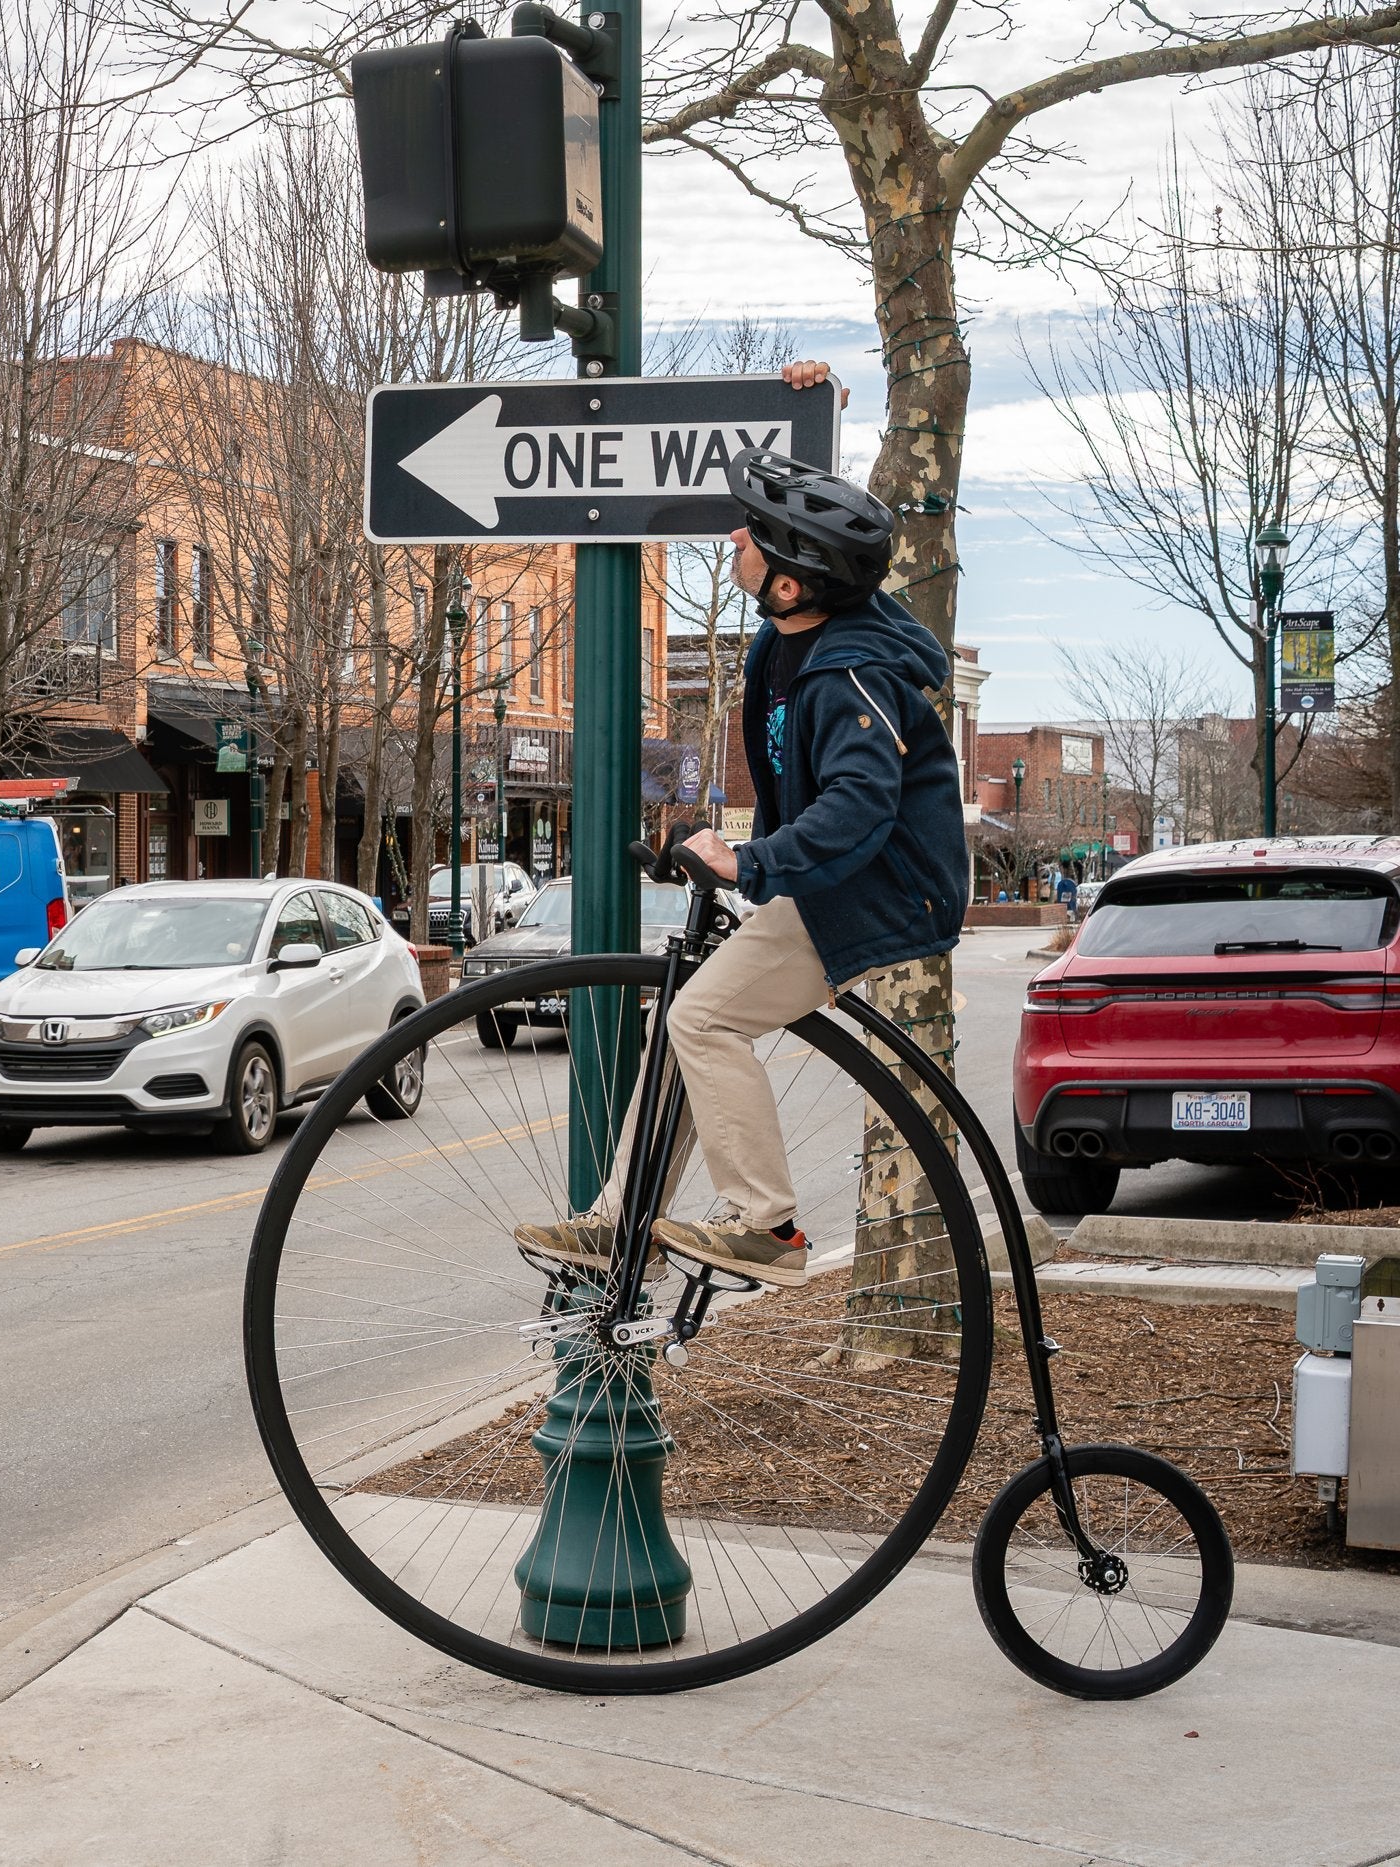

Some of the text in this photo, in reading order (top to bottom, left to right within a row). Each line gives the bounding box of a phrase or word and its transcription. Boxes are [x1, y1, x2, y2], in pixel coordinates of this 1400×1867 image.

[504, 431, 623, 489] ONE
[1145, 991, 1280, 1000] PORSCHE
[1176, 1102, 1245, 1120] LKB-3048
